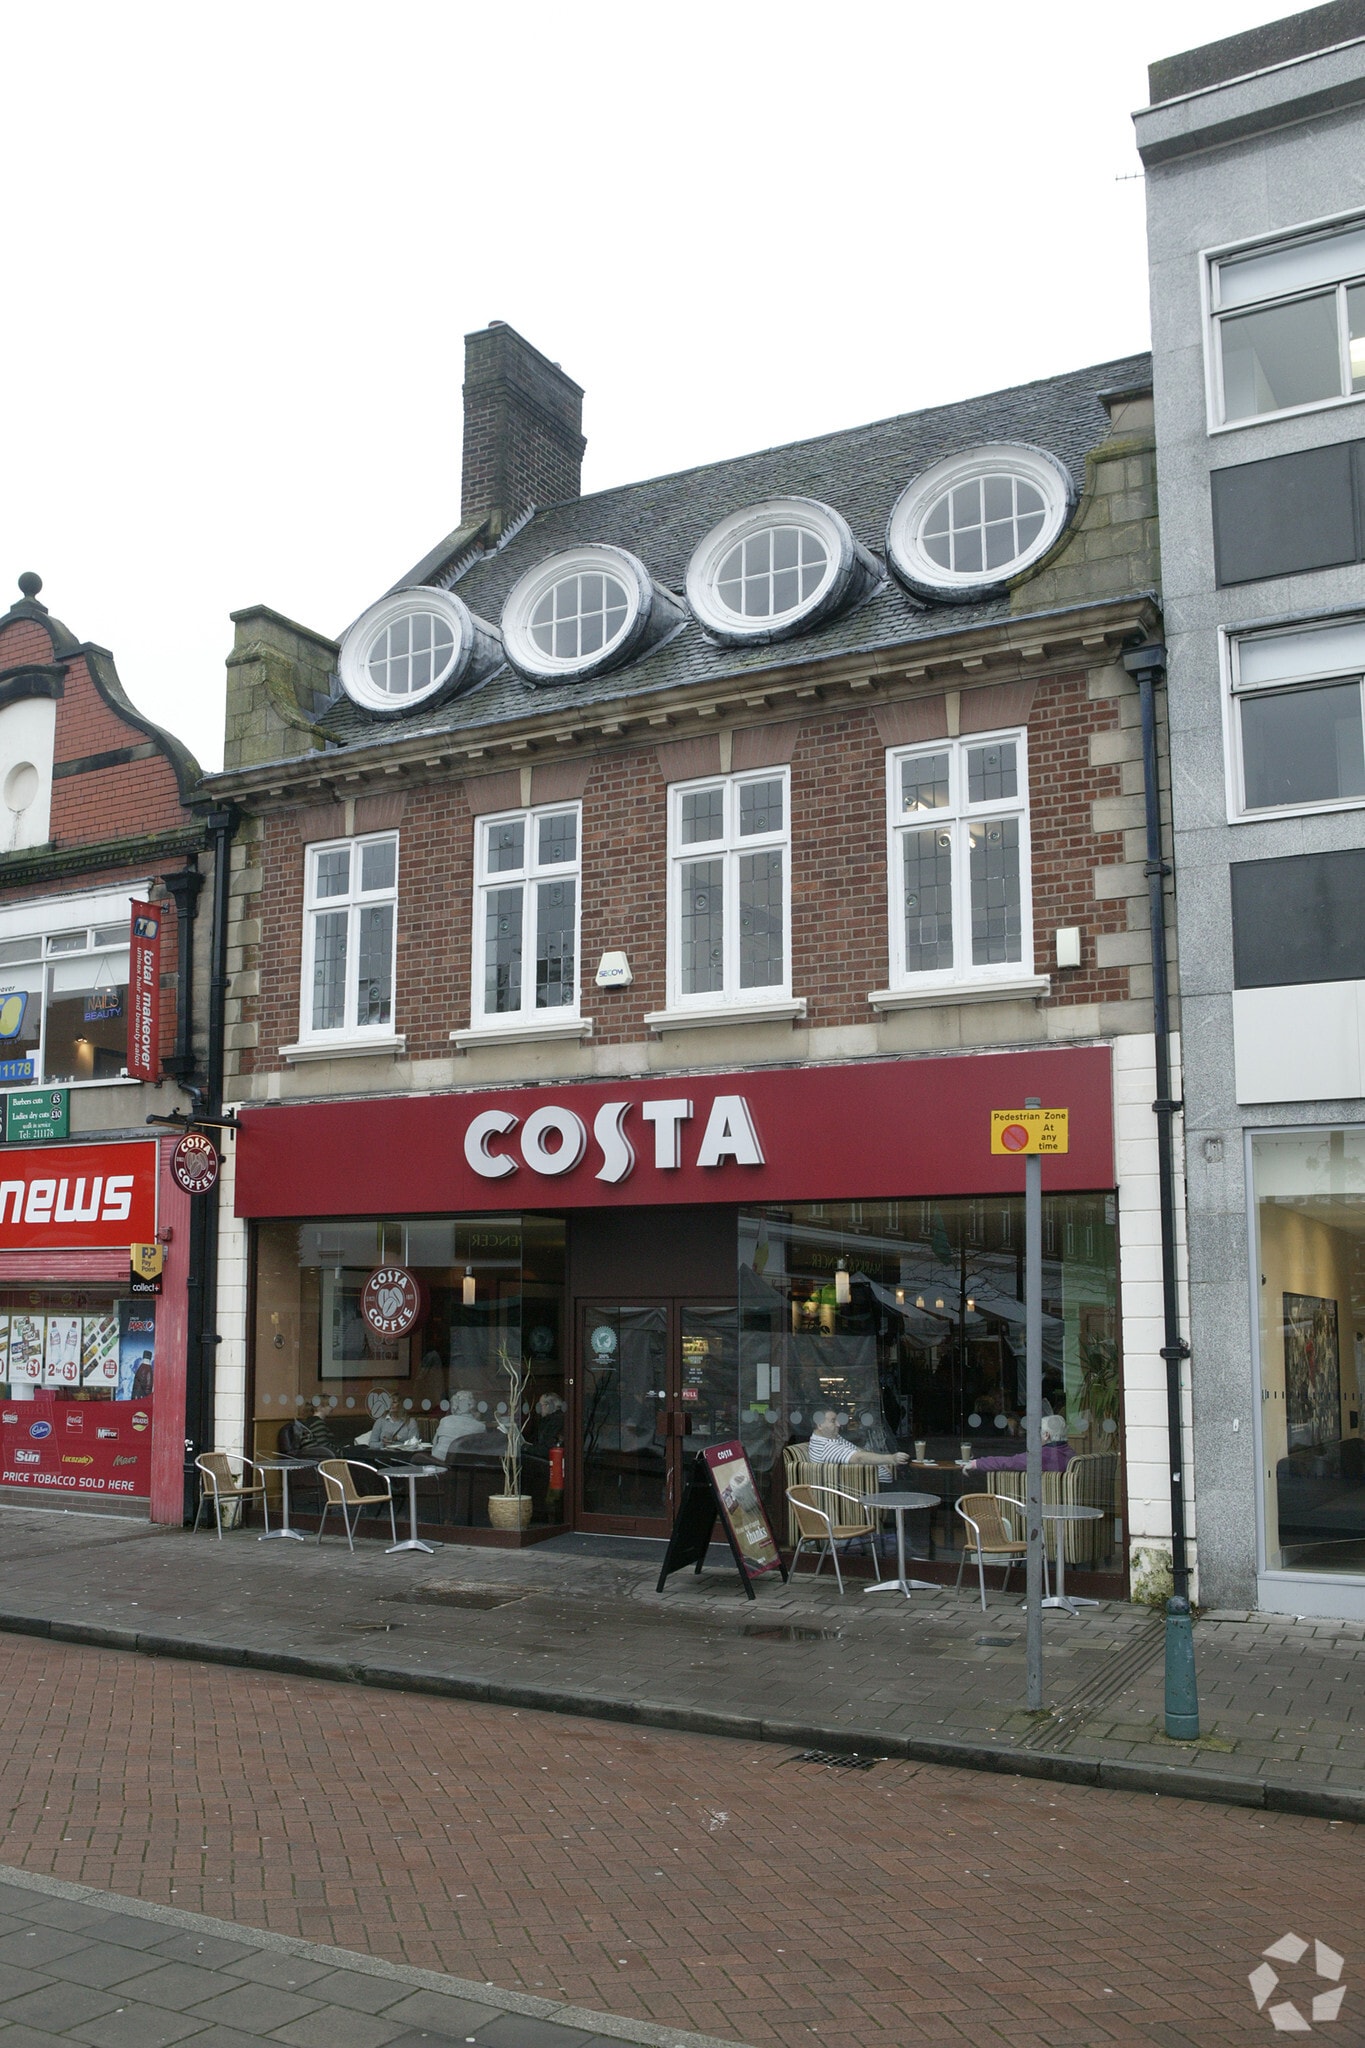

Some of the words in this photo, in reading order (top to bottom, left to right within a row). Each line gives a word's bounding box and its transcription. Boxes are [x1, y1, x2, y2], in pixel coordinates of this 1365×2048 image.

[143, 949, 154, 986] total
[599, 969, 624, 978] SECOM
[88, 993, 119, 1010] NAILS
[84, 1008, 121, 1021] BEAUTY
[141, 992, 153, 1071] makeover
[0, 1061, 31, 1077] 1178
[12, 1098, 32, 1106] Barbers
[52, 1093, 61, 1104] £5
[12, 1112, 28, 1120] Ladies
[29, 1111, 38, 1120] dry
[51, 1110, 62, 1119] £10
[994, 1113, 1040, 1121] Pedestrian
[1044, 1112, 1066, 1120] Zone
[19, 1130, 31, 1139] Tel:
[33, 1128, 54, 1138] 211178
[1043, 1124, 1055, 1132] At
[463, 1095, 766, 1183] COSTA
[1041, 1134, 1057, 1142] any
[181, 1137, 211, 1155] COSTA
[178, 1168, 214, 1190] COFFEE
[0, 1175, 134, 1223] news
[371, 1270, 408, 1289] COSTA
[132, 1283, 159, 1292] collect+
[369, 1307, 413, 1331] COFFEE
[27, 1361, 39, 1376] £1
[48, 1363, 55, 1376] 2
[64, 1363, 76, 1378] £1
[16, 1450, 40, 1464] Sun
[62, 1454, 89, 1464] Lucozade
[113, 1455, 138, 1467] Mars
[717, 1449, 733, 1460] COSTA
[2, 1471, 30, 1483] PRICE
[33, 1473, 76, 1487] TOBACCO
[78, 1477, 105, 1489] SOLD
[108, 1480, 135, 1491] HERE
